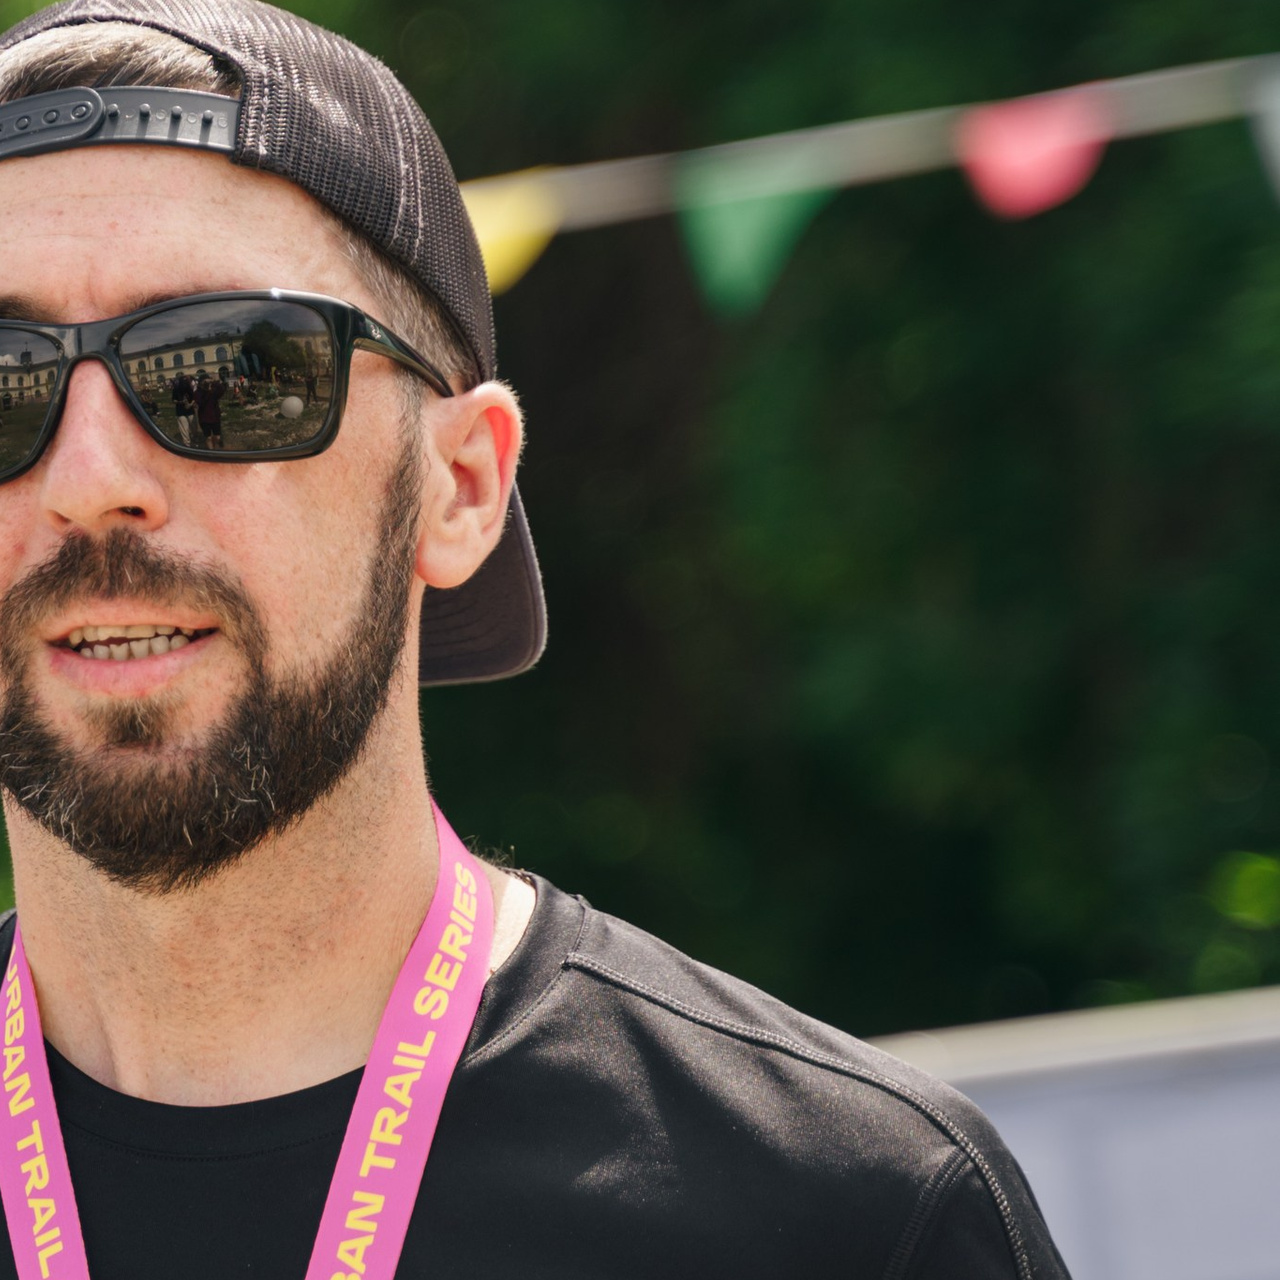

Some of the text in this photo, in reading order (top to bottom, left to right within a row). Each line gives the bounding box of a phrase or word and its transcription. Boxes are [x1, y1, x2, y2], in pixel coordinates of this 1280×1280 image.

[3, 943, 36, 1118] URBAN
[360, 1030, 436, 1178] TRAIL
[414, 861, 477, 1020] SERIES
[16, 1119, 64, 1279] TRAIL
